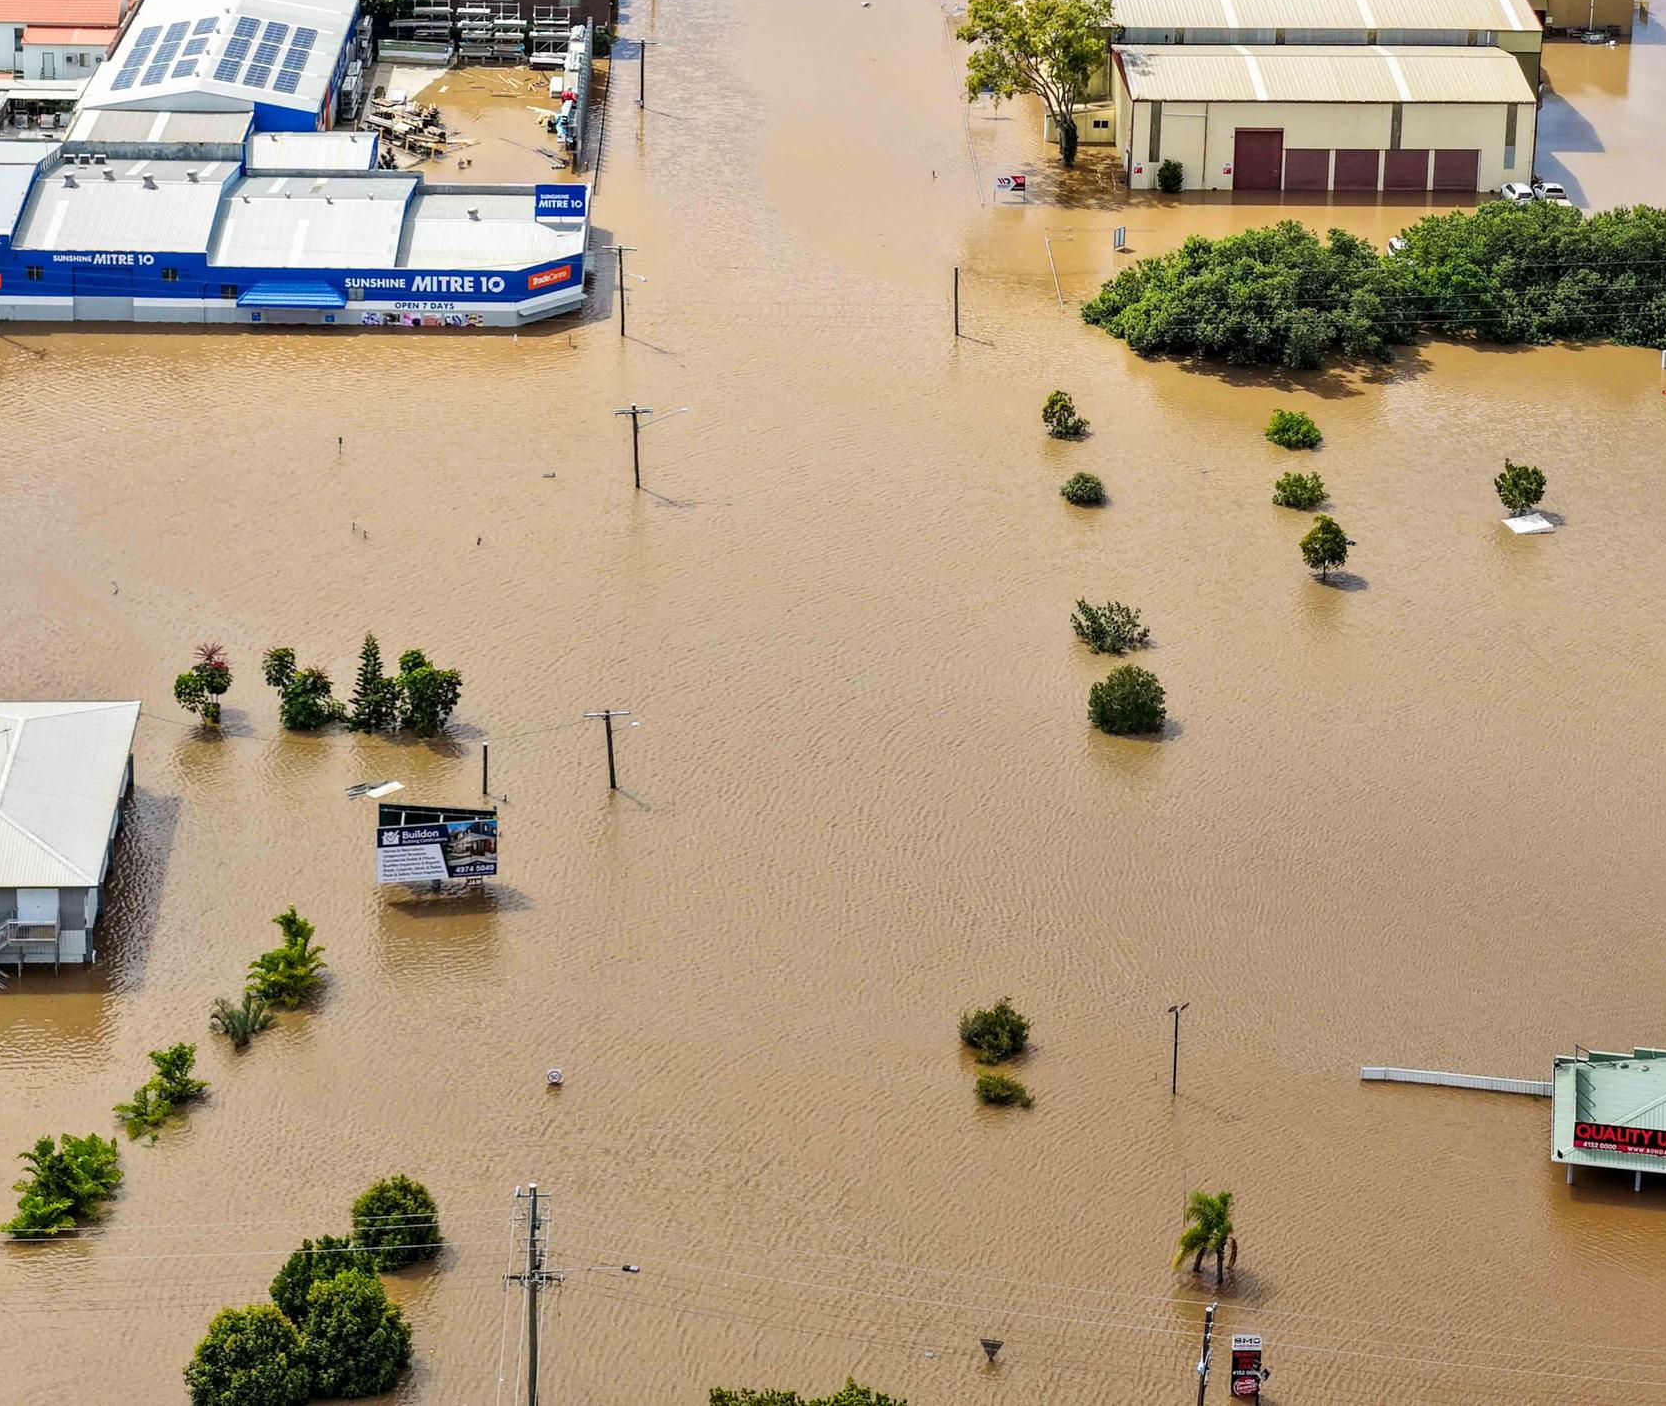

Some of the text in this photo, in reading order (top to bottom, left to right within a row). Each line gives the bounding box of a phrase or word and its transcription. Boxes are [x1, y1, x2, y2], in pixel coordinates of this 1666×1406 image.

[538, 199, 583, 209] MITRE 10
[52, 252, 154, 266] SUNSHINE MITRE 10
[344, 276, 505, 293] SUNSHINE MITRE 10
[532, 270, 568, 286] TradeCentre
[395, 302, 454, 310] OPEN 7 DAYS
[402, 829, 439, 839] Buildon
[1576, 1124, 1652, 1144] QUALITY
